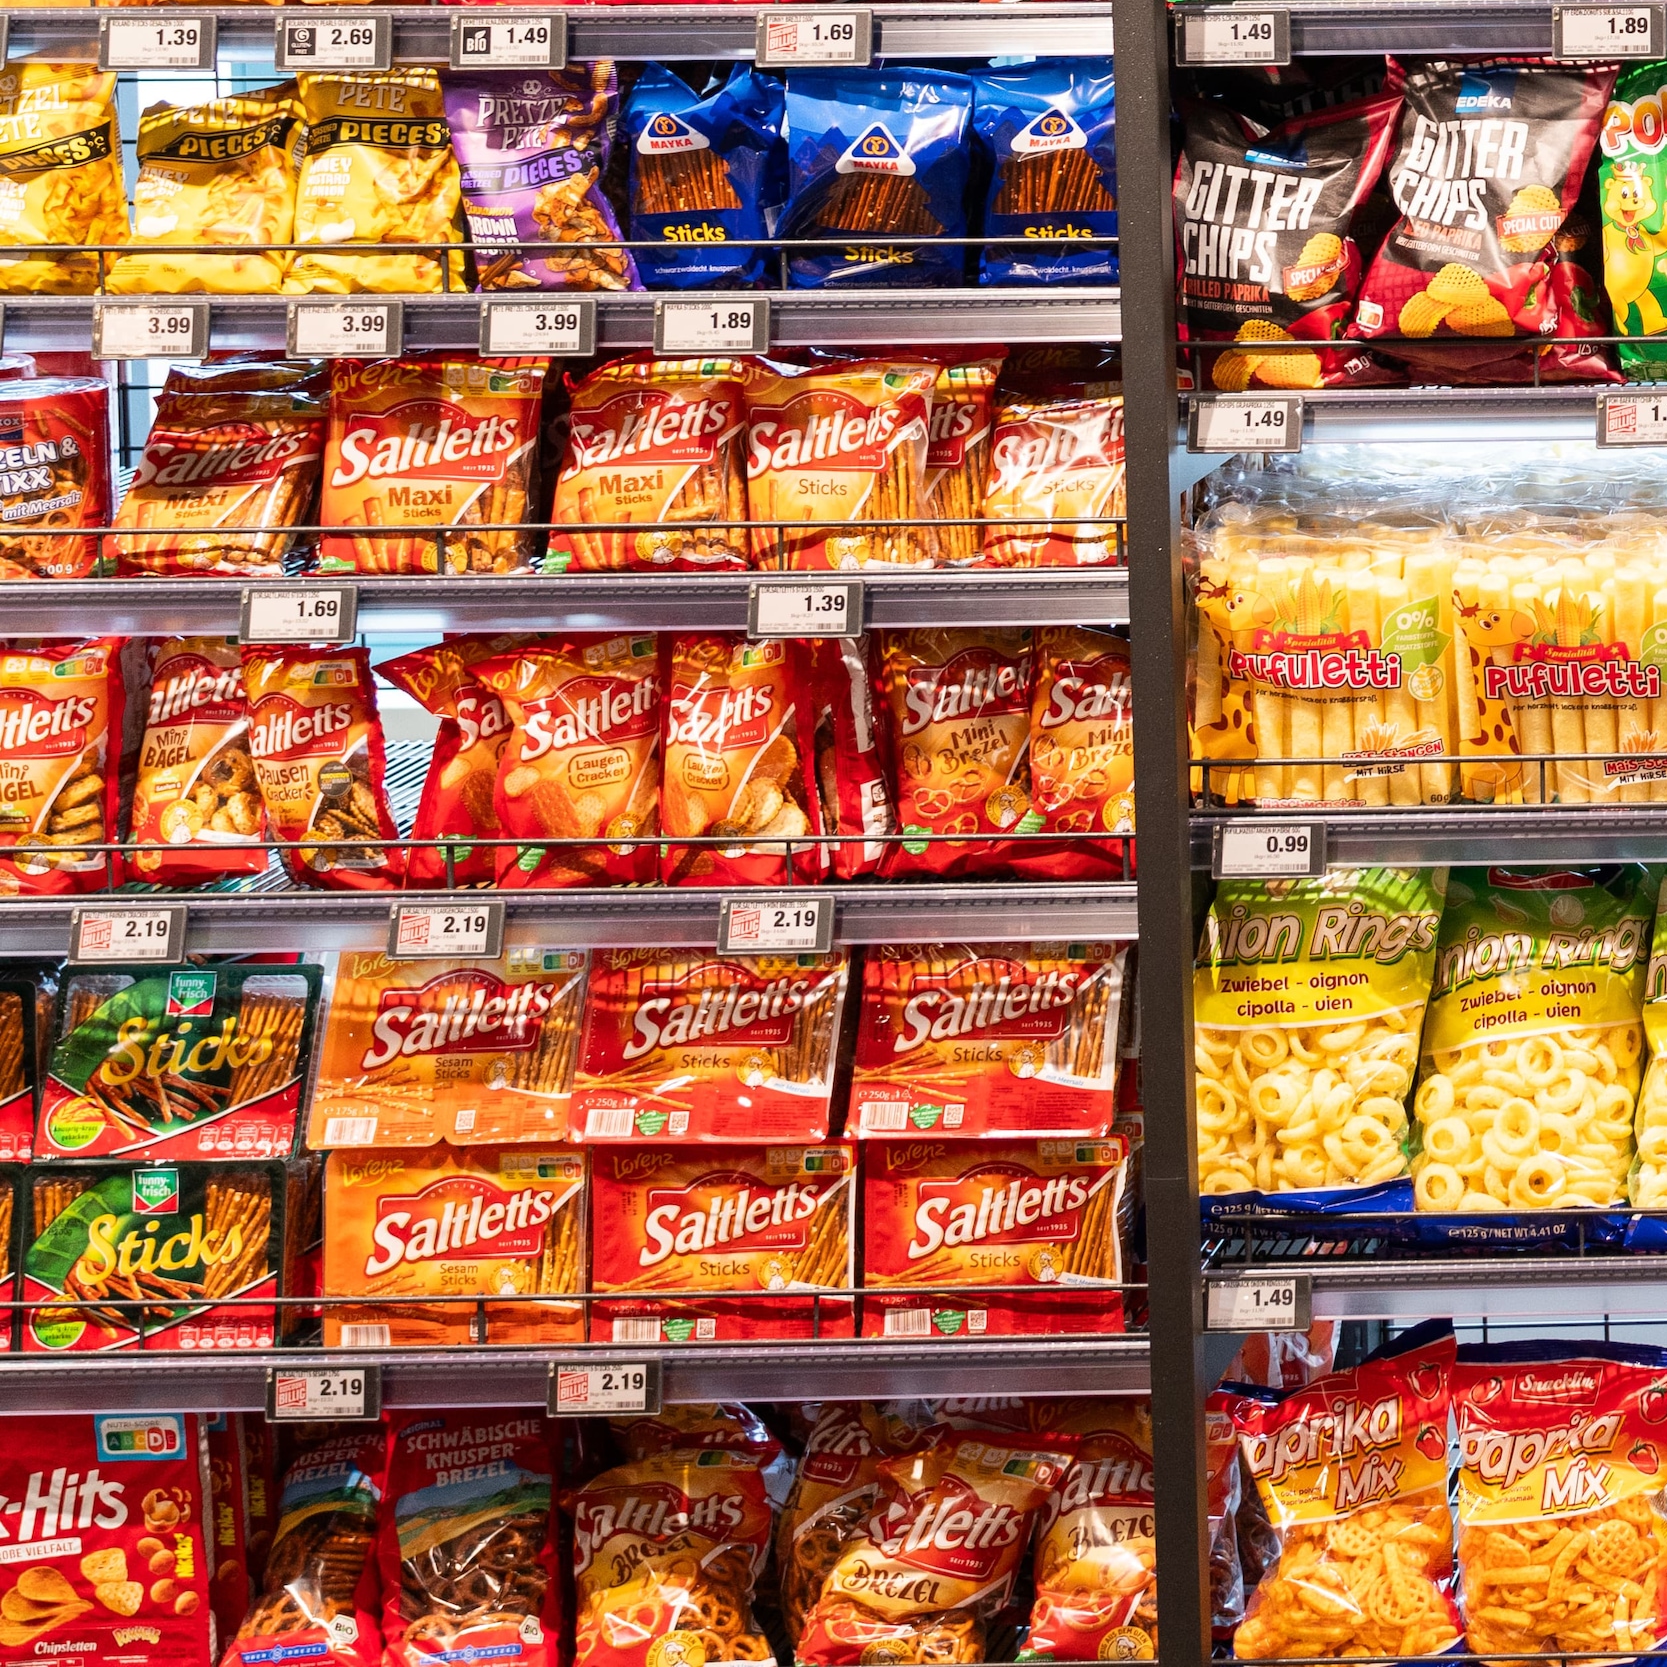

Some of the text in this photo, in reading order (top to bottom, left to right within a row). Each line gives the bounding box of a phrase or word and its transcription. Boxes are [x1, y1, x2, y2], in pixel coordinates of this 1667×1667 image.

[1607, 17, 1649, 34] 1.89
[155, 29, 198, 46] 1.39
[331, 28, 373, 46] 2.69
[507, 27, 548, 45] 1.49
[340, 120, 442, 144] PIECES
[650, 140, 694, 150] MAYKA
[663, 224, 726, 243] Sticks
[148, 318, 190, 334] 3.99
[710, 312, 751, 329] 1.89
[388, 485, 453, 509] Maxi
[403, 507, 442, 518] Sticks
[297, 600, 338, 617] 1.69
[1396, 611, 1435, 631] 0%
[575, 753, 623, 772] Laugen
[256, 764, 308, 785] Pausen
[576, 766, 626, 783] Cracker
[1266, 835, 1308, 855] 0.99
[365, 1187, 552, 1277] Saltletts
[77, 1215, 242, 1286] Sticks
[439, 1263, 479, 1275] Sesam
[440, 1274, 477, 1286] Sticks
[320, 1378, 362, 1396] 2.19
[1520, 1373, 1598, 1400] Snackline
[406, 1419, 541, 1453] SCHWÄBISCHE
[426, 1441, 521, 1469] KNUSPER-
[436, 1462, 510, 1488] BREZEL
[35, 1640, 97, 1655] Chipsletten
